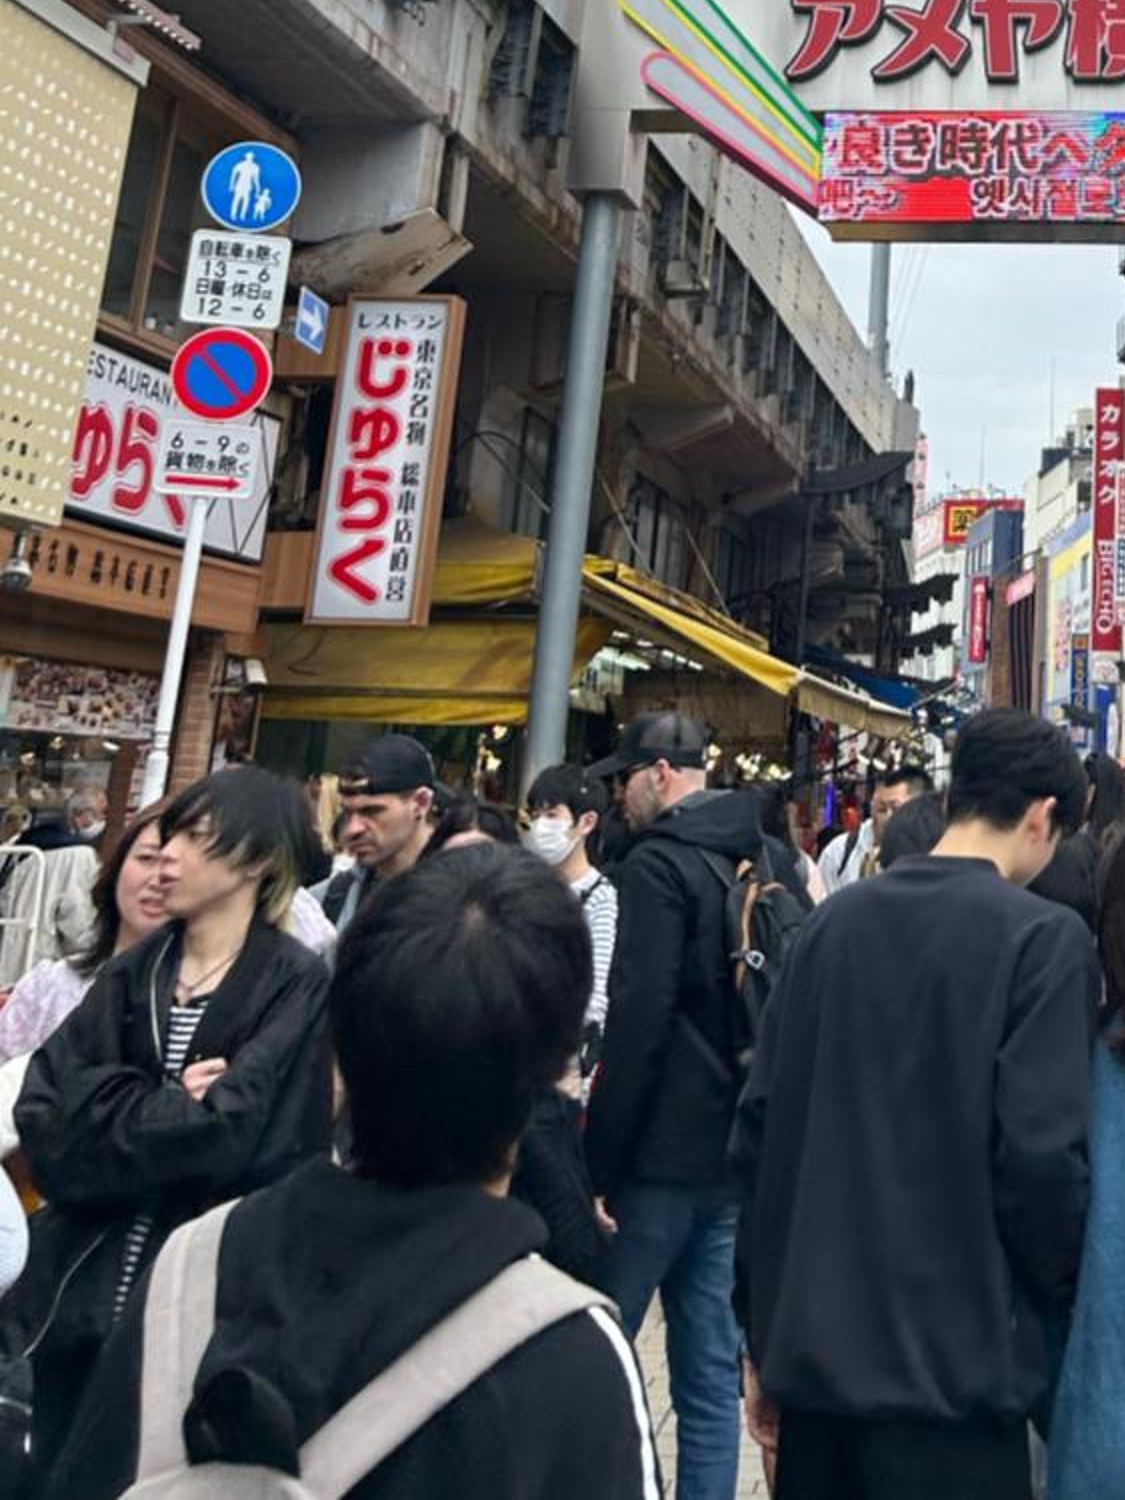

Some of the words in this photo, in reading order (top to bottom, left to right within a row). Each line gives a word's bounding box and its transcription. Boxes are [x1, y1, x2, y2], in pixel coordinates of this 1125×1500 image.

[199, 240, 281, 262] 自転車を除く
[357, 313, 442, 330] レストラン
[328, 338, 412, 603] じゅらく
